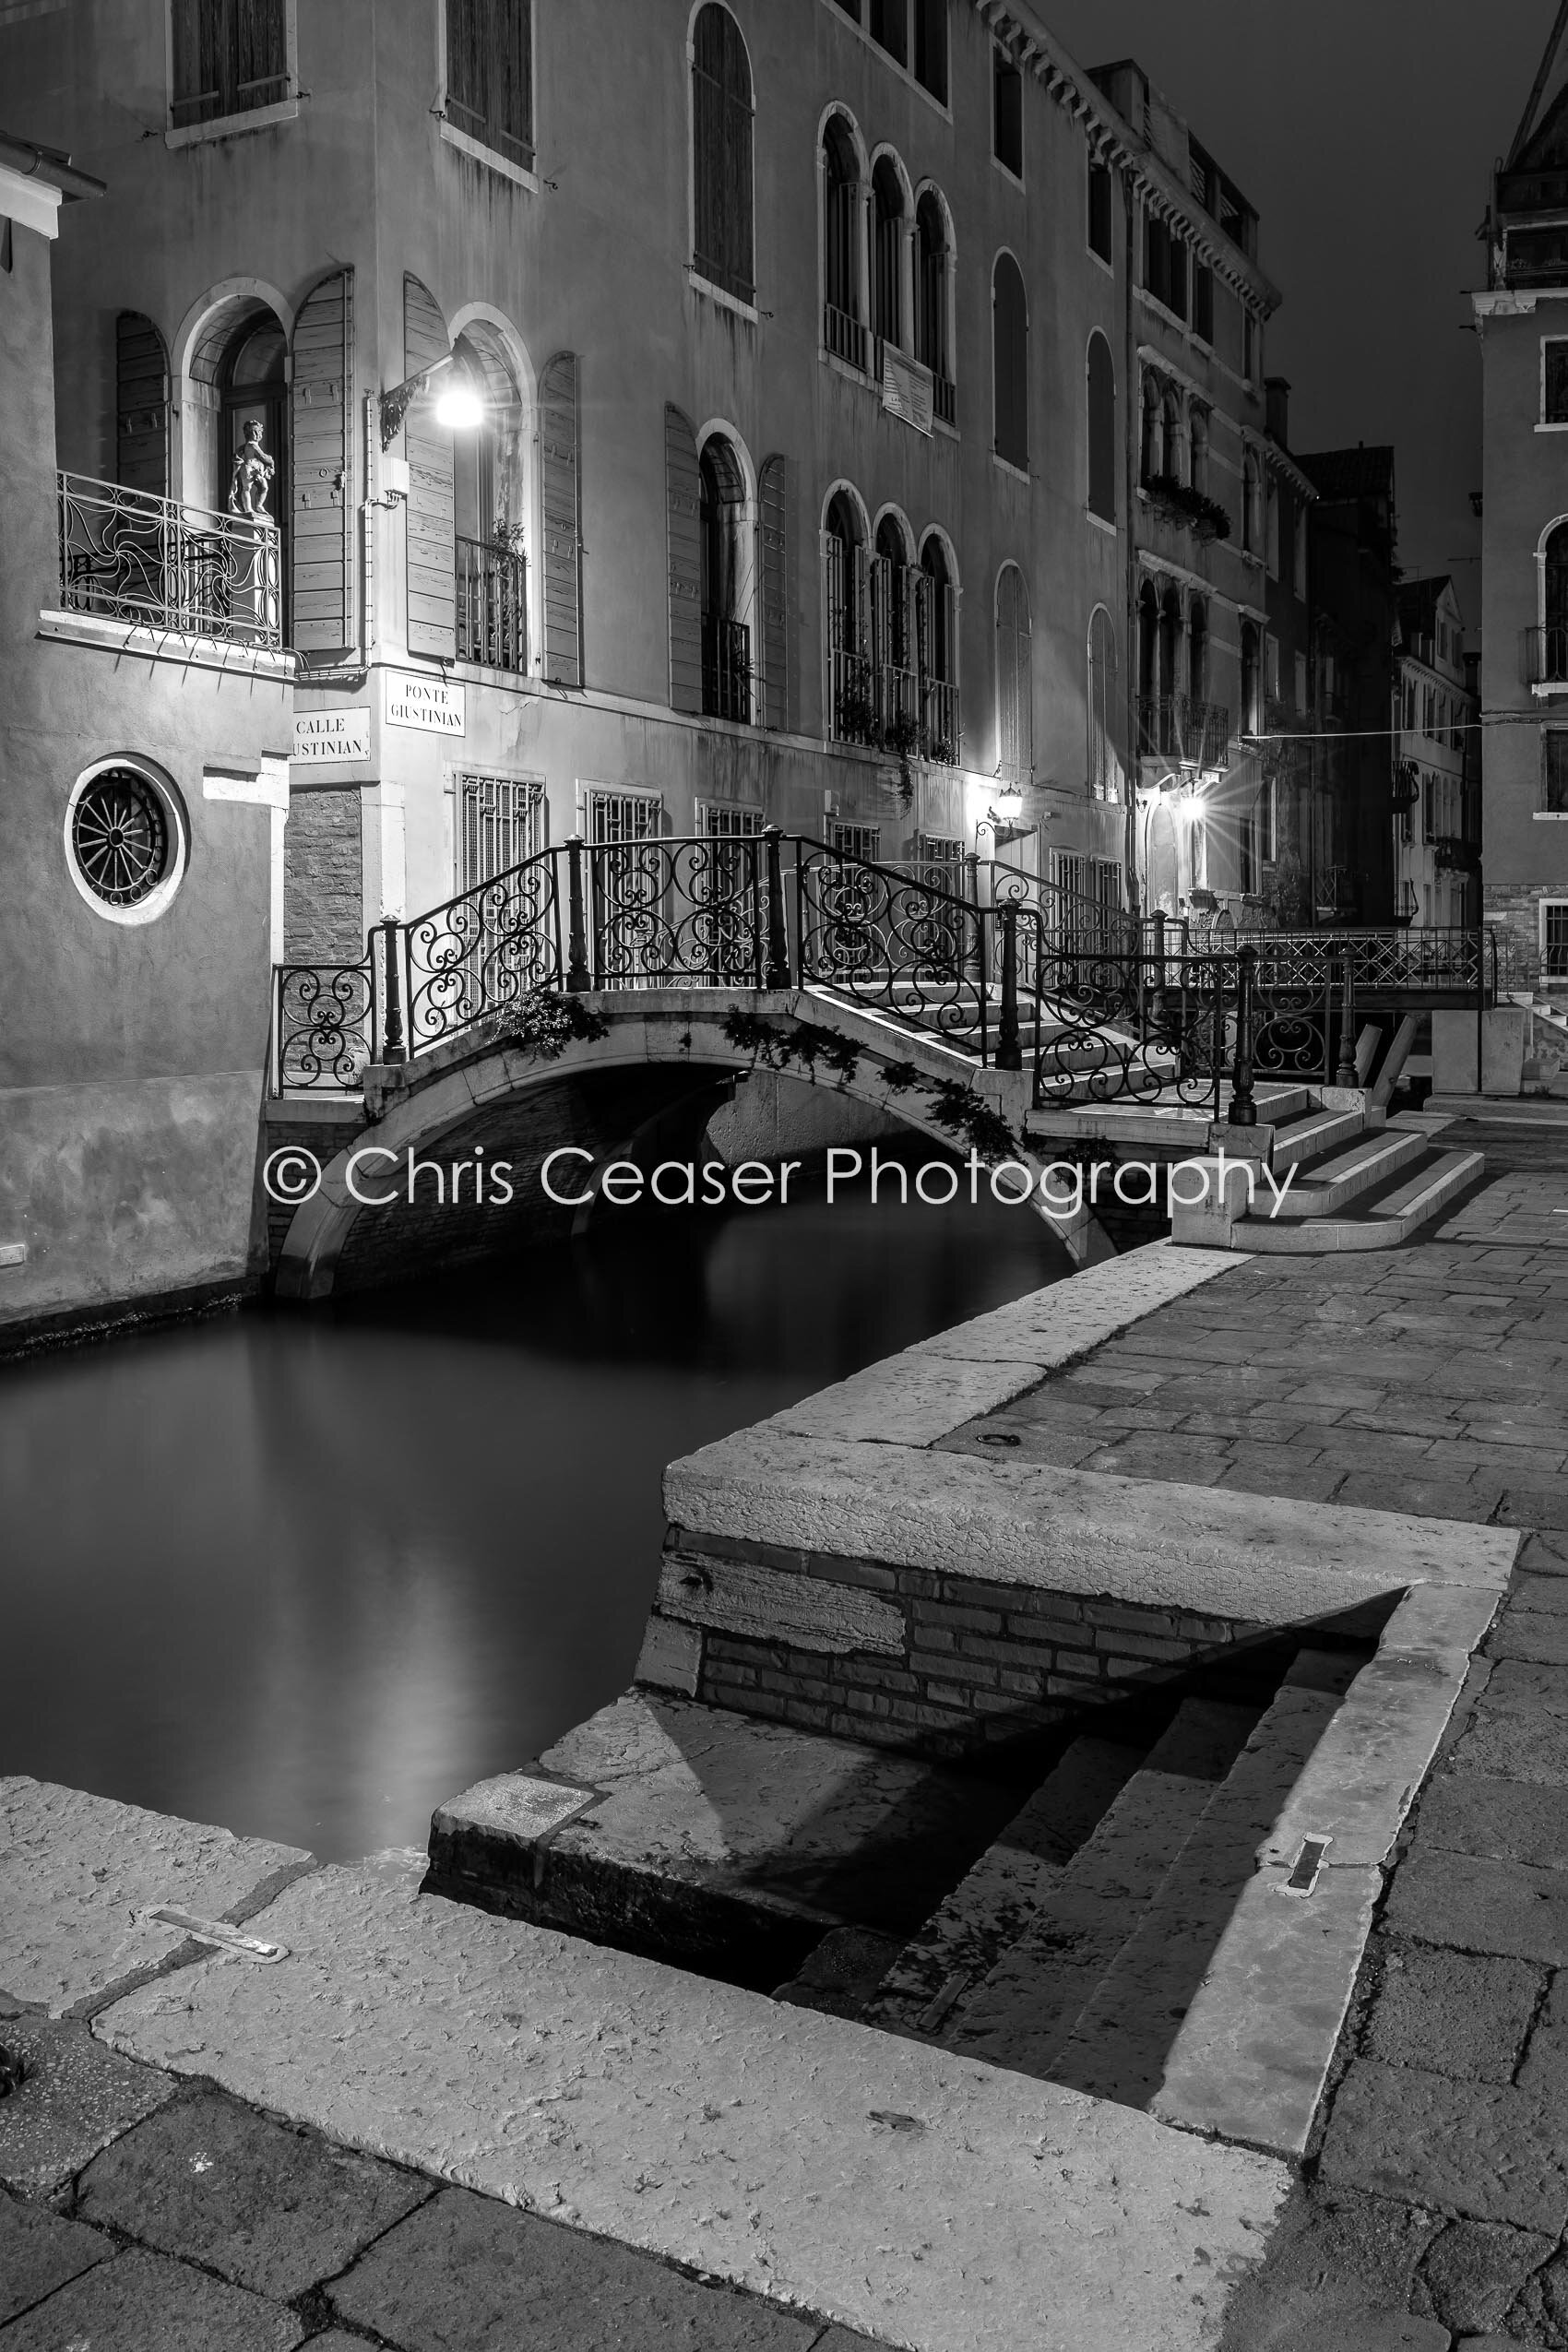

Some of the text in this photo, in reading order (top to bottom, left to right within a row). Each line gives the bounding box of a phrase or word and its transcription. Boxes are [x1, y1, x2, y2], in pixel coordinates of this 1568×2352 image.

[406, 684, 448, 704] PONTE
[391, 704, 461, 726] GIUSTINIAN
[296, 719, 345, 734] CALLE
